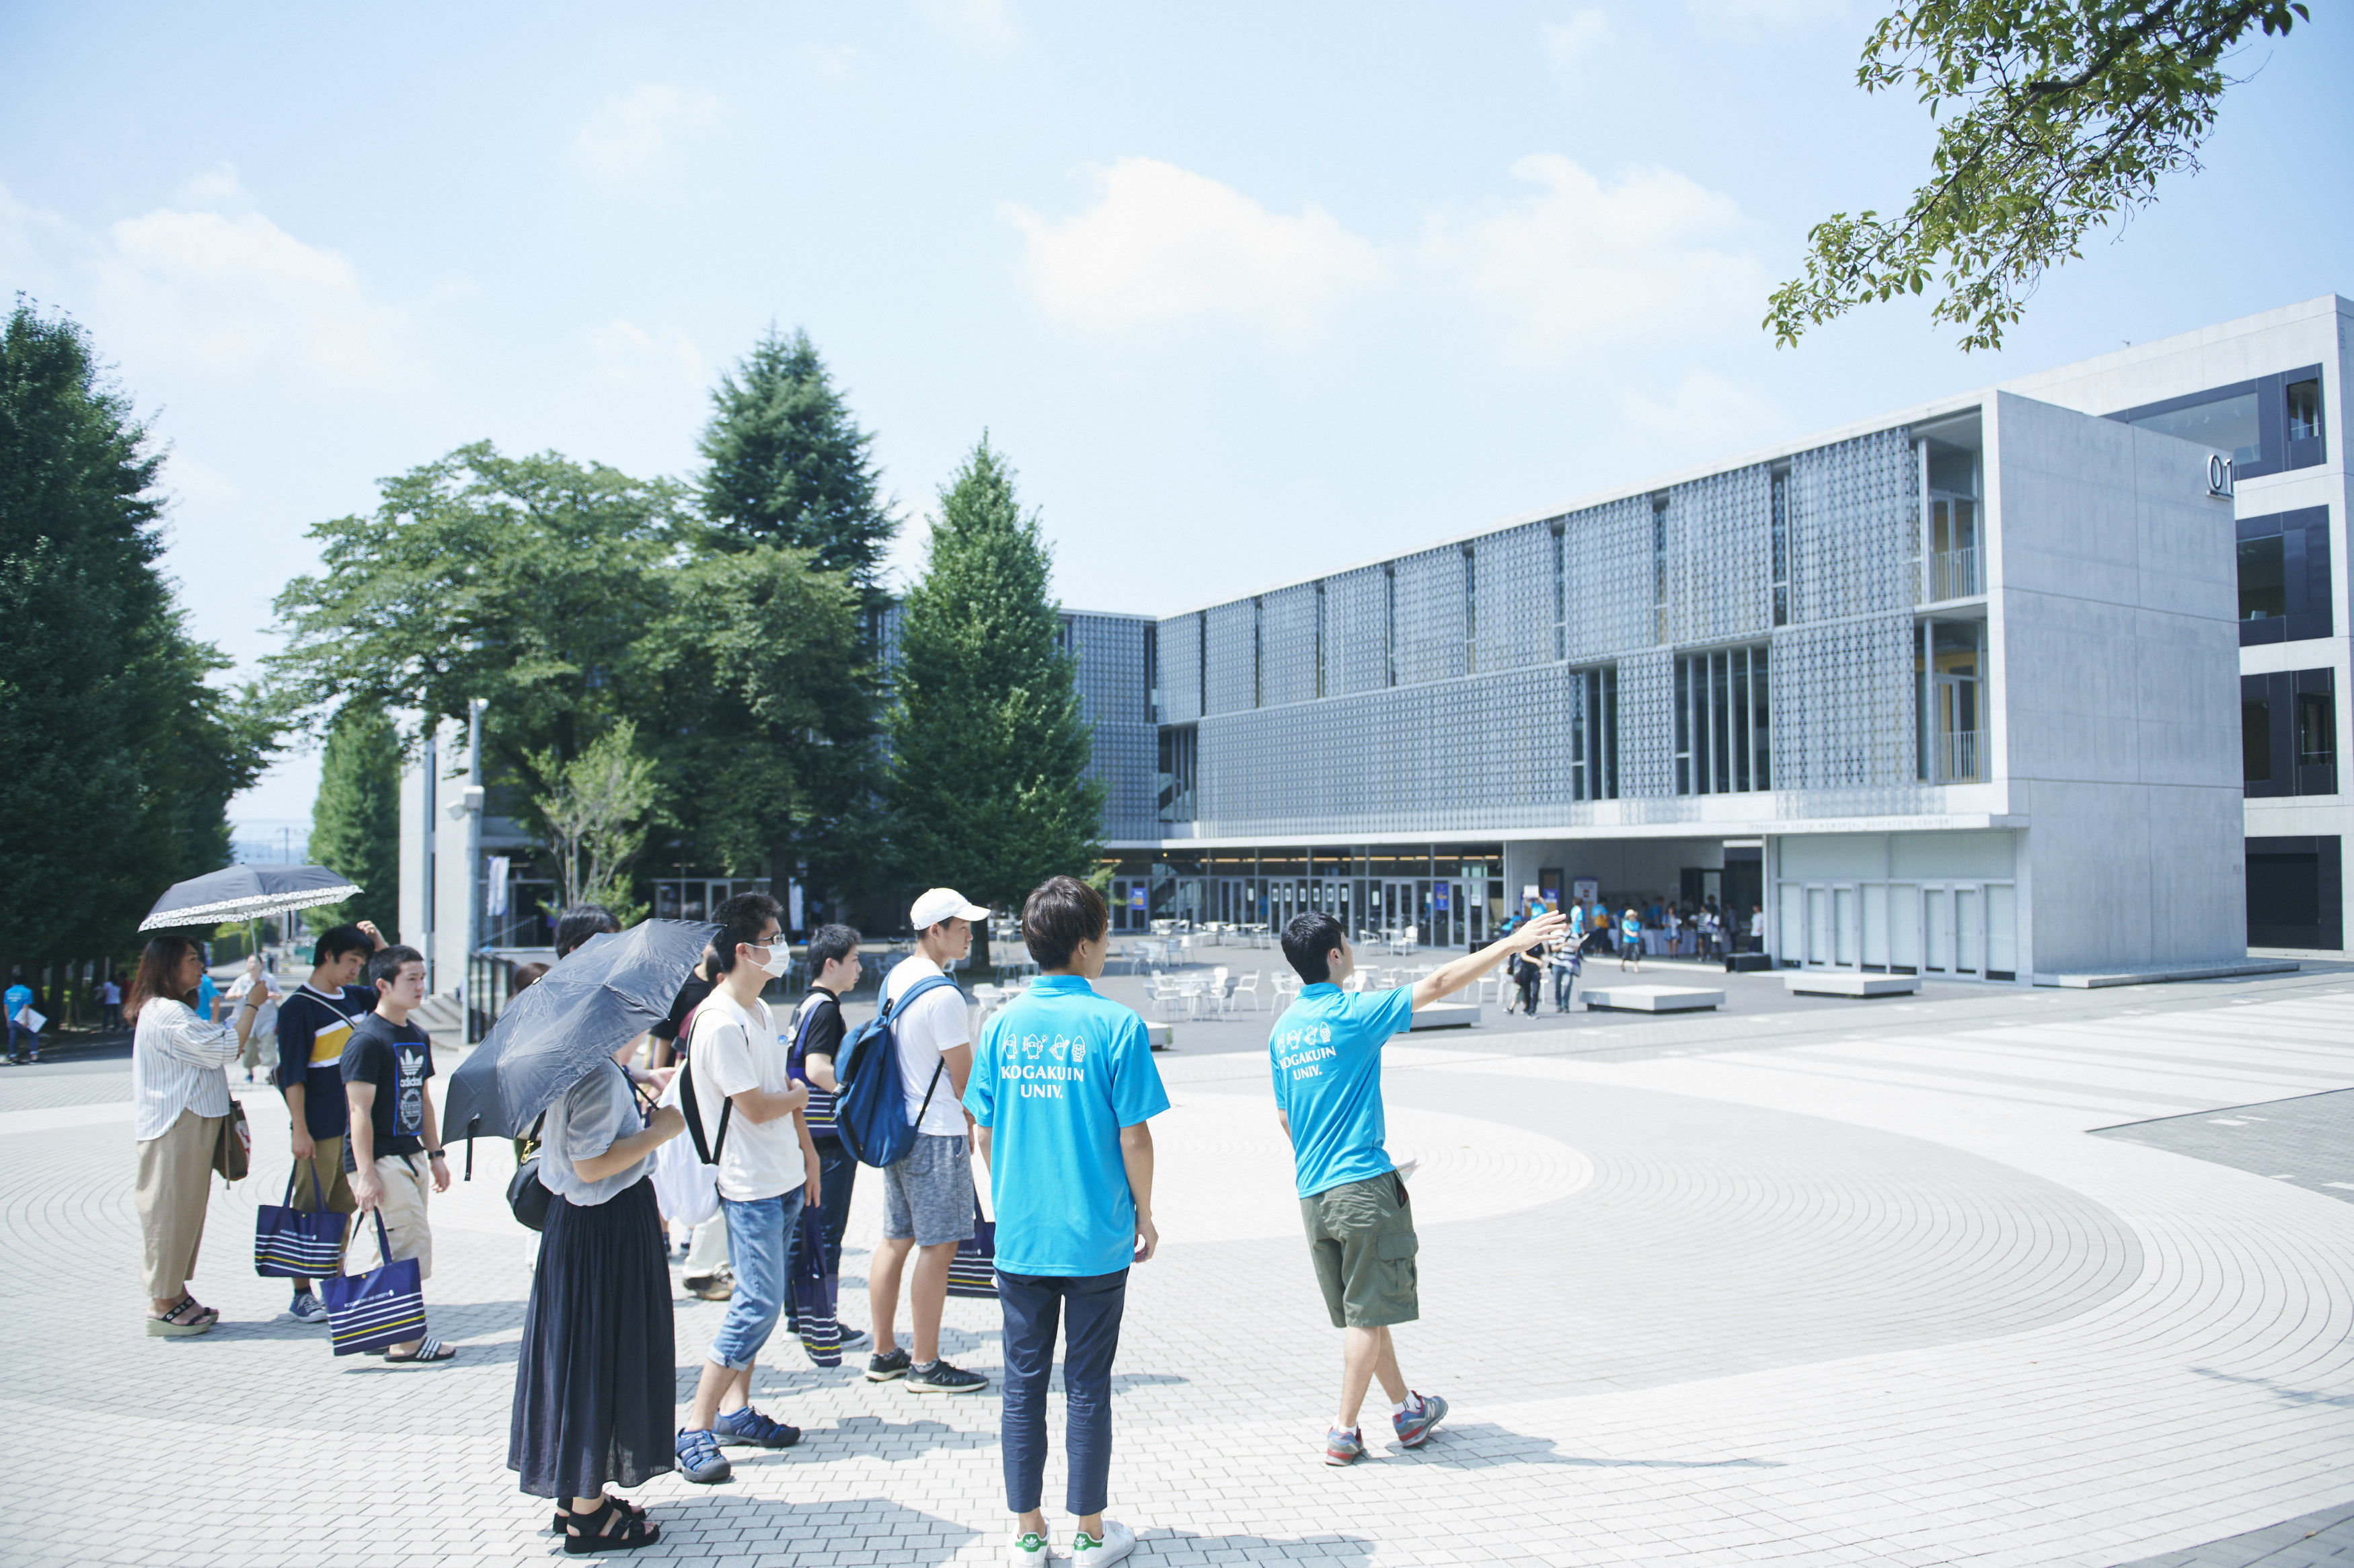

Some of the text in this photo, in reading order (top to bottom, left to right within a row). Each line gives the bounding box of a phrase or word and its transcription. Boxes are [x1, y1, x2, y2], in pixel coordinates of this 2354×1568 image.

[2207, 454, 2234, 494] 01
[1000, 1065, 1085, 1083] KOGAKUIN
[1293, 1064, 1323, 1081] UNIV.
[400, 1076, 423, 1088] adidas
[1020, 1084, 1063, 1099] UNIV.
[1427, 1403, 1435, 1419] N
